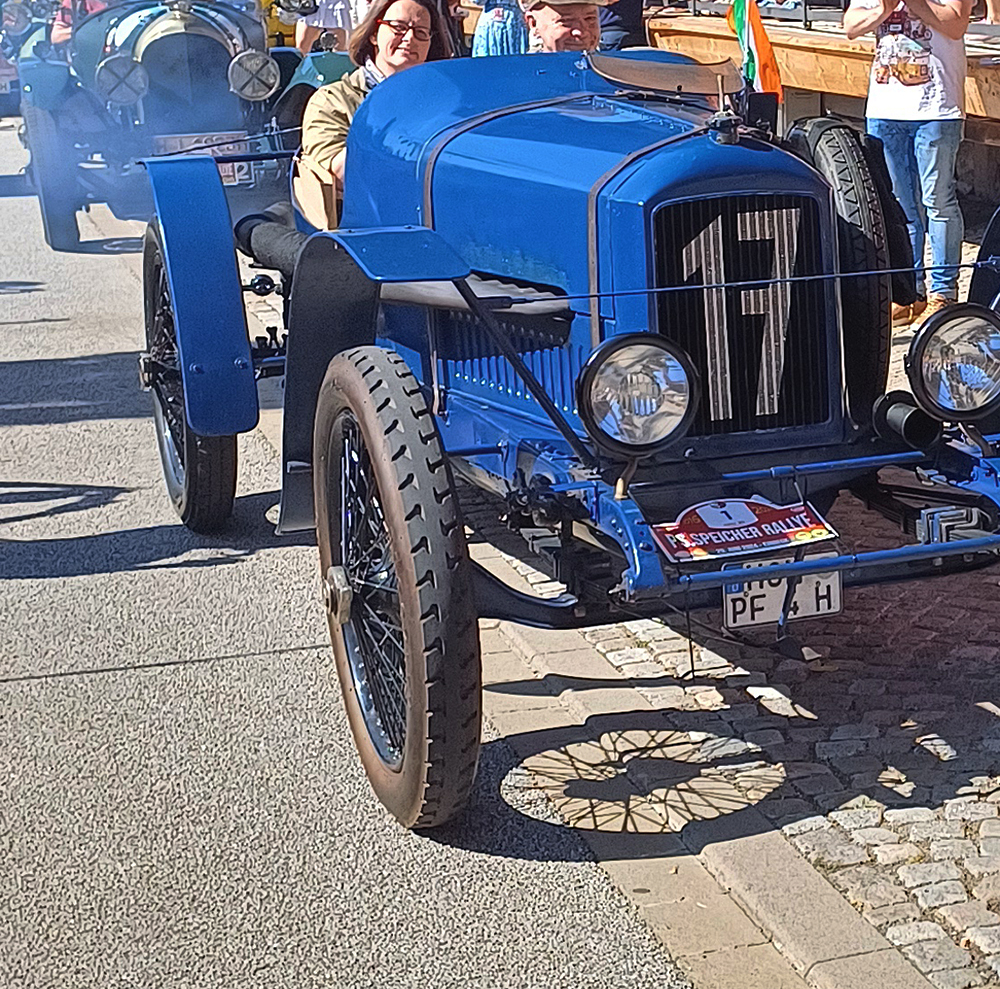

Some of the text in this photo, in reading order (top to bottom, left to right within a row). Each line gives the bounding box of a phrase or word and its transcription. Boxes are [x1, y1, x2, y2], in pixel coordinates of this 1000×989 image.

[682, 208, 800, 422] 17
[664, 526, 763, 549] PS.SPEICHER
[761, 512, 817, 535] RALLYE
[720, 510, 733, 521] 1
[731, 593, 767, 624] PF
[815, 583, 832, 612] H
